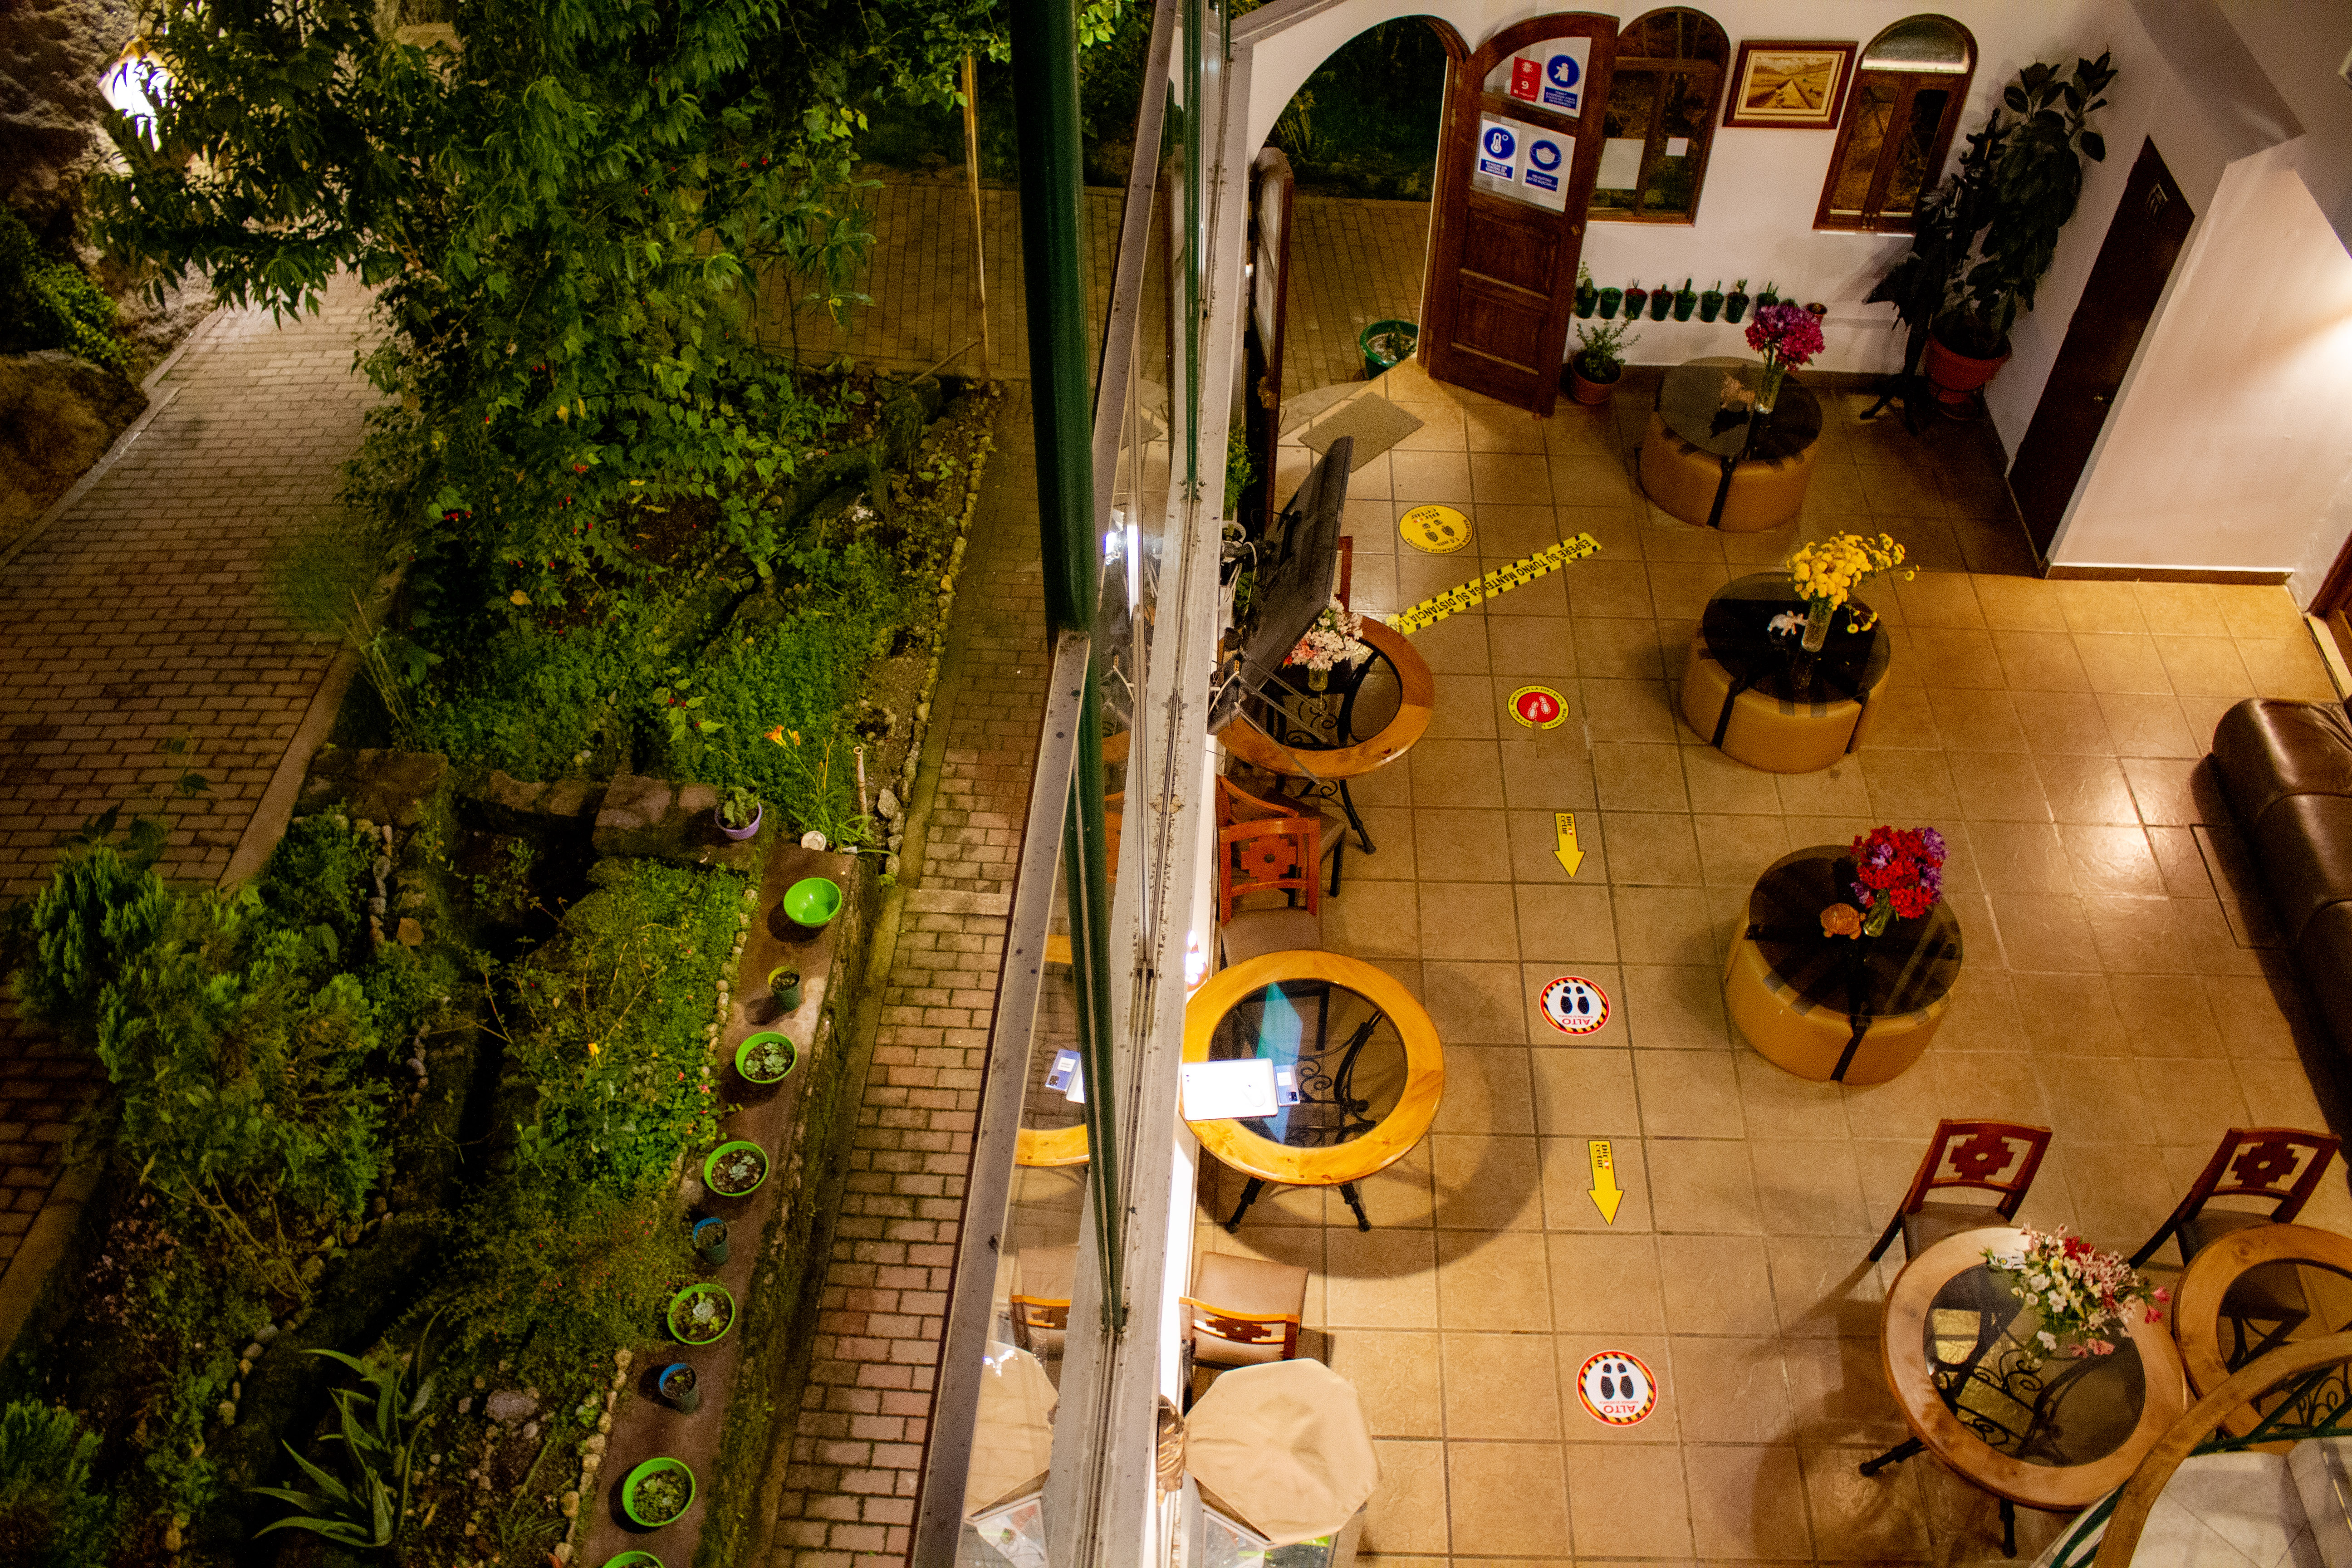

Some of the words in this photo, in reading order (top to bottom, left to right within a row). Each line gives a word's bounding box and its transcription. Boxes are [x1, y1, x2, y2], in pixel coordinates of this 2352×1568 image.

[1521, 81, 1529, 90] 9
[1406, 537, 1429, 551] SEGURA
[1431, 543, 1464, 553] DISTANCIA
[1557, 539, 1592, 558] ESPERE
[1545, 553, 1560, 563] SU
[1516, 559, 1548, 576] TURNO
[1468, 572, 1517, 596] MANTEGA
[1455, 592, 1470, 603] SU
[1409, 598, 1456, 622] DISTANCIA
[1540, 687, 1564, 705] DISTANCIA
[1603, 1405, 1636, 1413] ALTO
